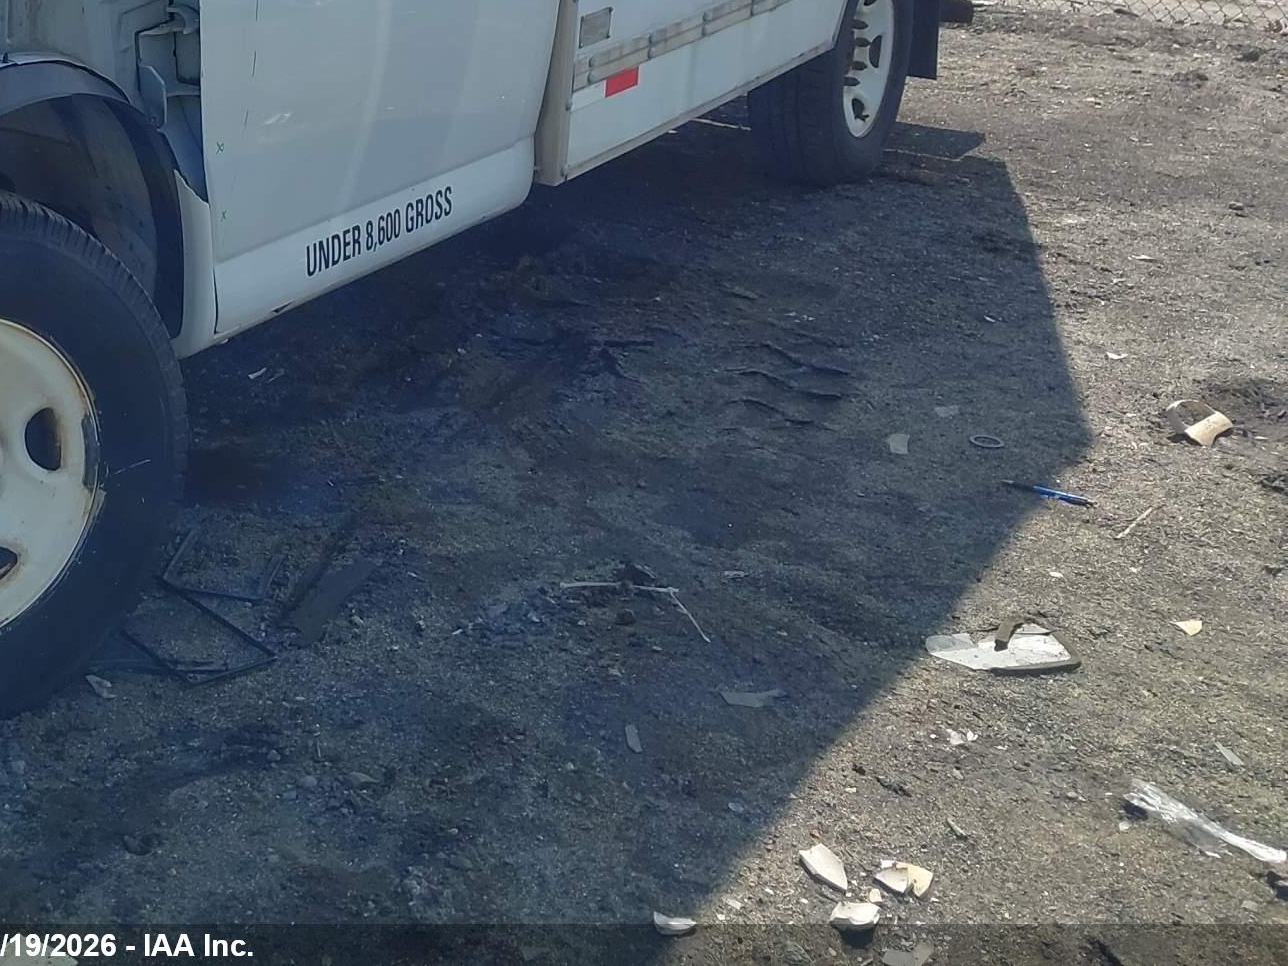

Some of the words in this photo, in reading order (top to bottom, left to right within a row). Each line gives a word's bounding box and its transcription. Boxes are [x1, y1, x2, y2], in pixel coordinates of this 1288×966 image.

[305, 224, 361, 277] UNDER
[365, 208, 401, 252] 8,600
[405, 186, 452, 233] GROSS
